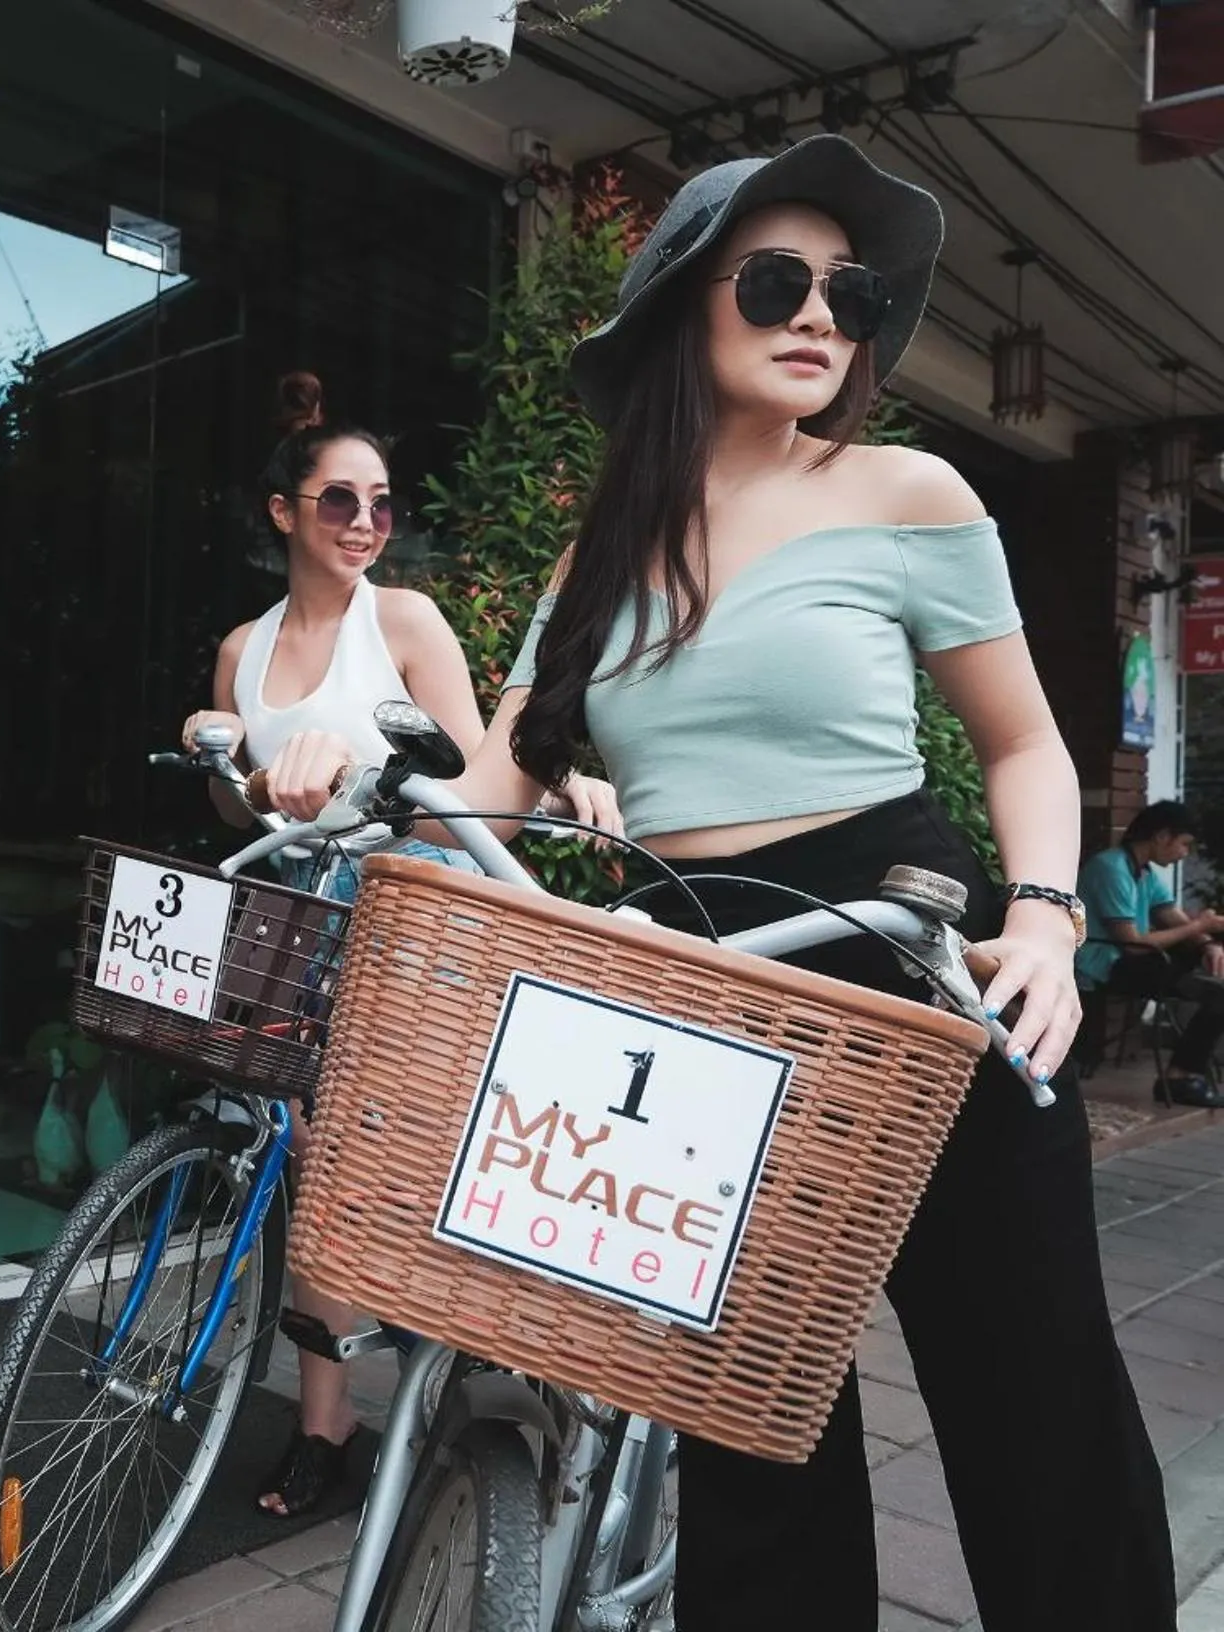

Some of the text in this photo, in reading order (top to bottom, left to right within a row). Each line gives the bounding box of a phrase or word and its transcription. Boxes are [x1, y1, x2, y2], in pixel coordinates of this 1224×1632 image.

[113, 910, 163, 940] MY
[155, 873, 184, 918] 3
[109, 931, 213, 980] PLACE
[103, 960, 207, 1012] Hotel
[607, 1048, 656, 1125] 1
[491, 1093, 612, 1160] MY
[478, 1133, 724, 1251] PLACE
[462, 1181, 708, 1300] Hotel
